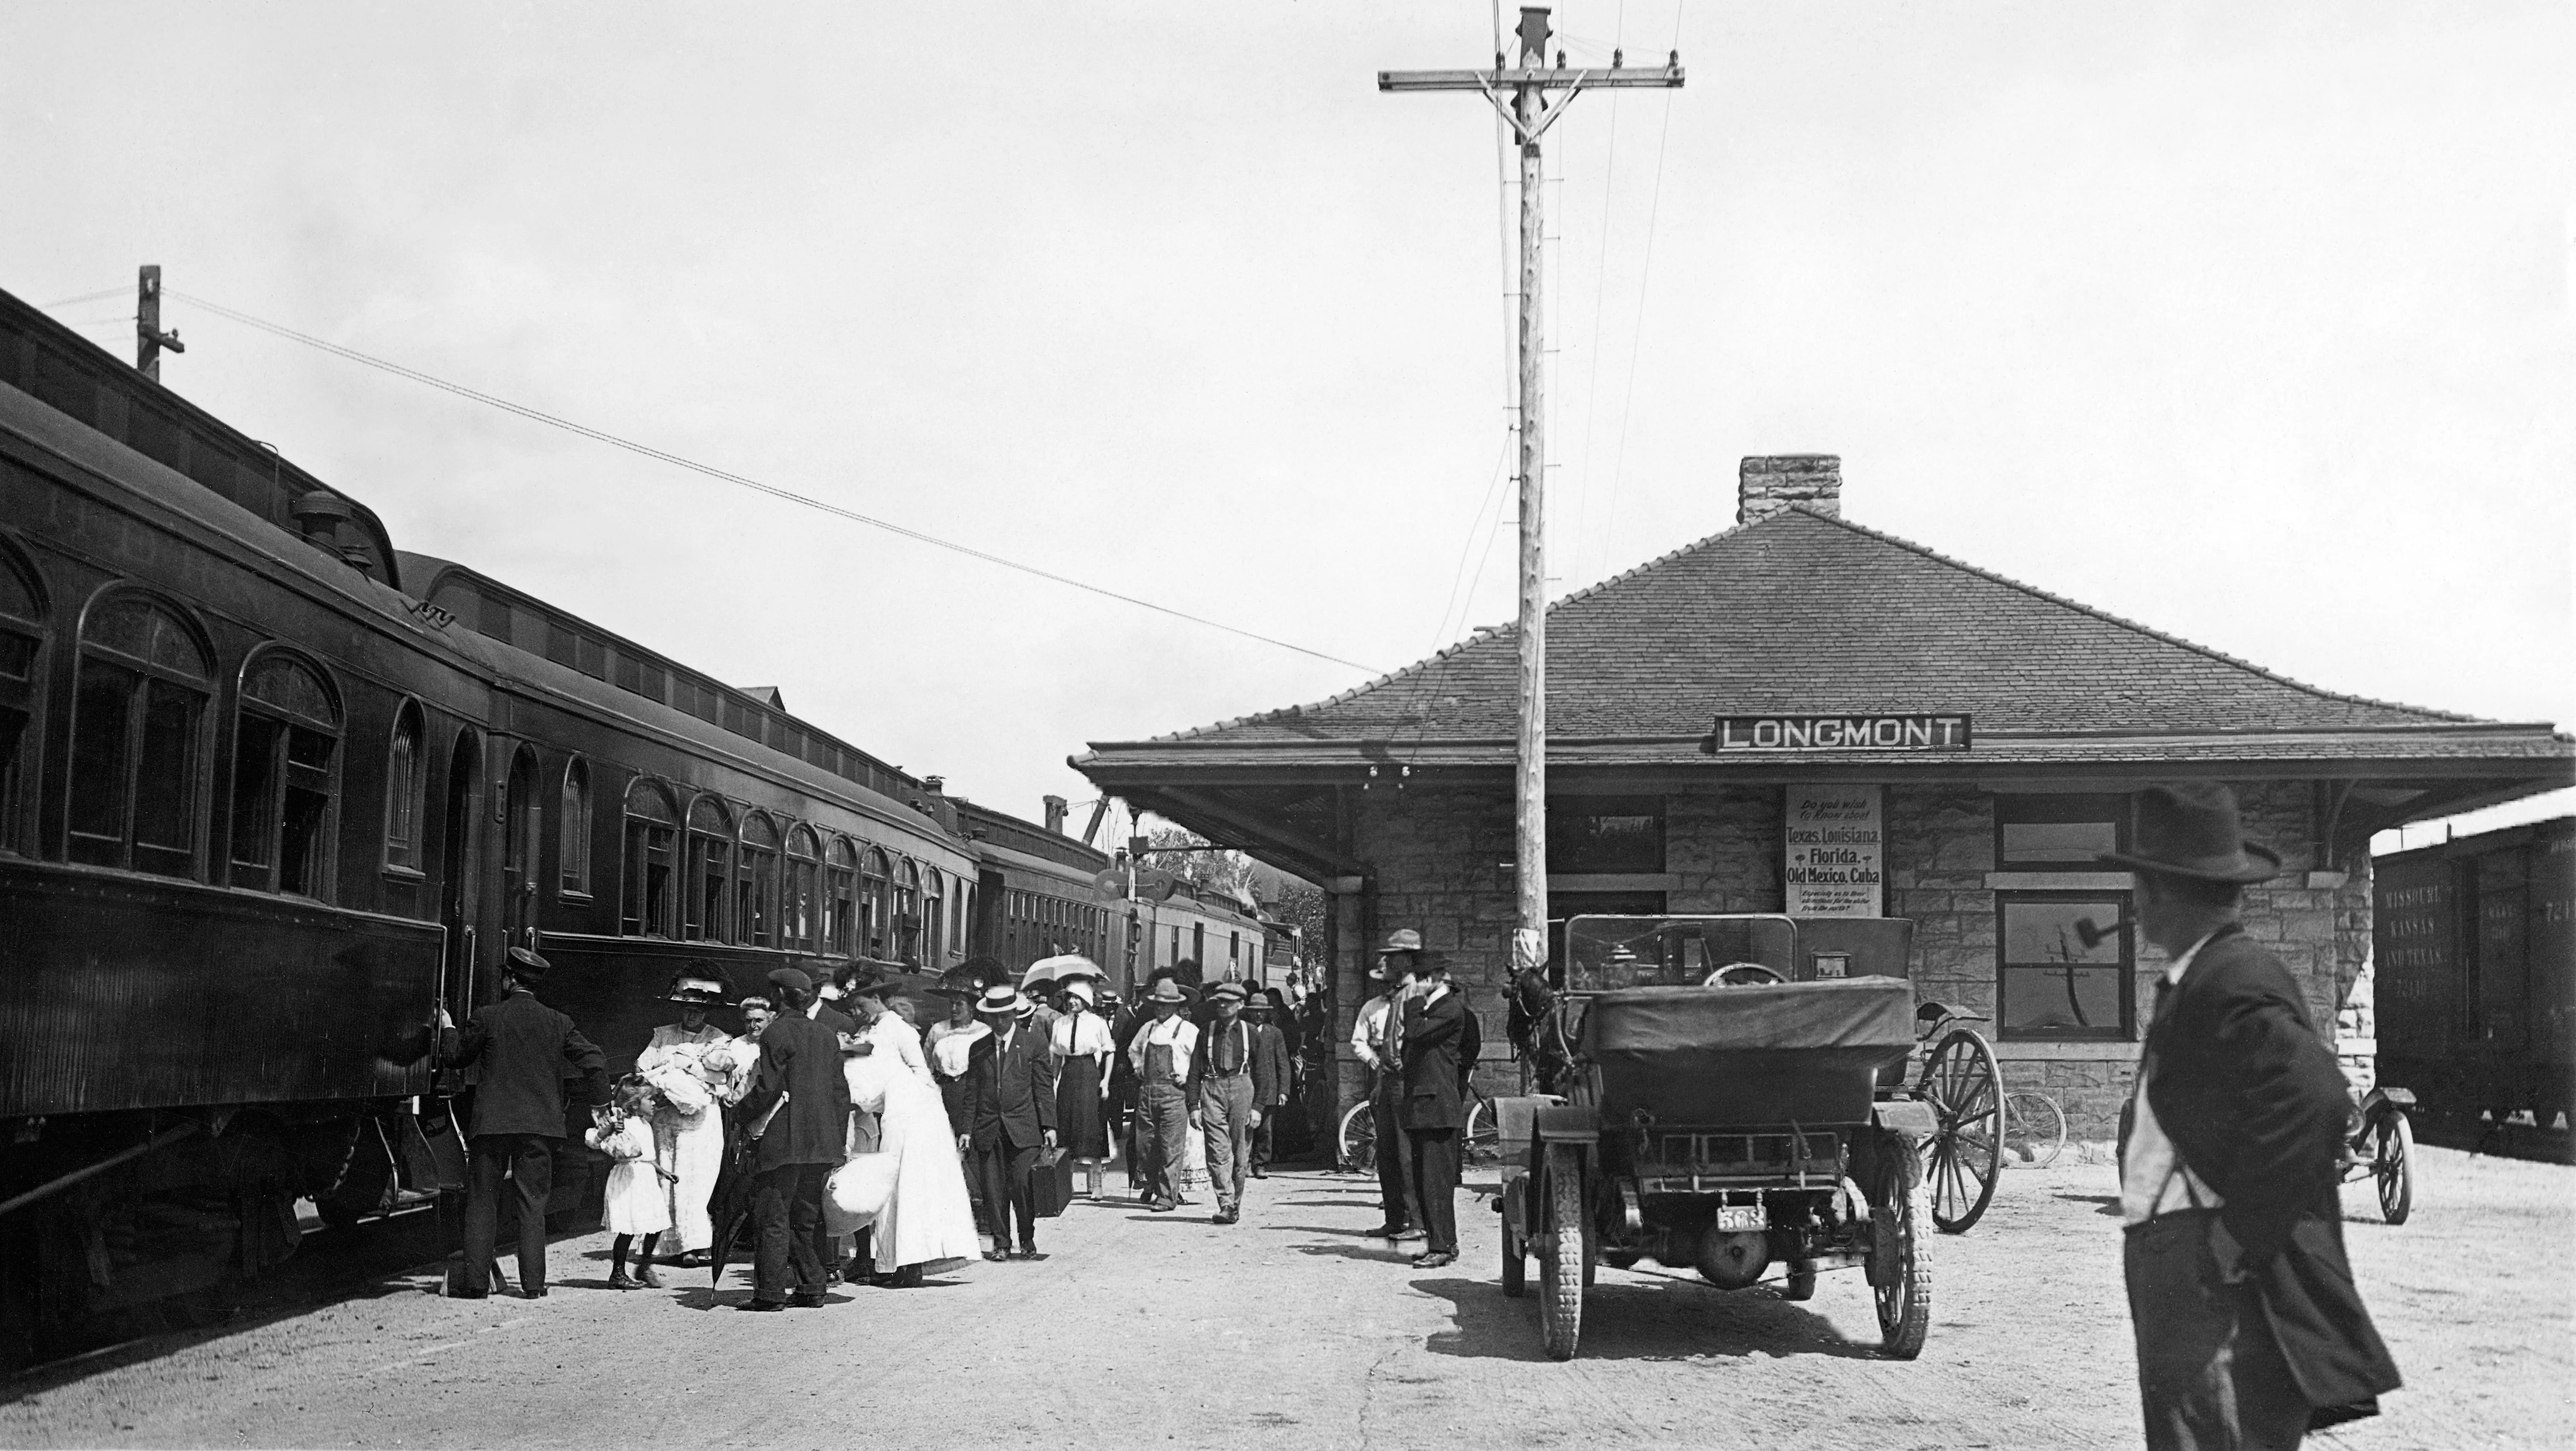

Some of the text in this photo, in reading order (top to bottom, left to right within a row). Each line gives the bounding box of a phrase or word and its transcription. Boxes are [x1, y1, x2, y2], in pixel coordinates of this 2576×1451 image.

[1722, 718, 1962, 748] LONGMONT
[1801, 799, 1867, 812] Do you wish
[1810, 848, 1861, 864] Florida,
[1787, 867, 1806, 883] Old
[1850, 867, 1880, 883] Cuba
[2390, 917, 2434, 938] KANSAS
[2385, 949, 2404, 967] AND
